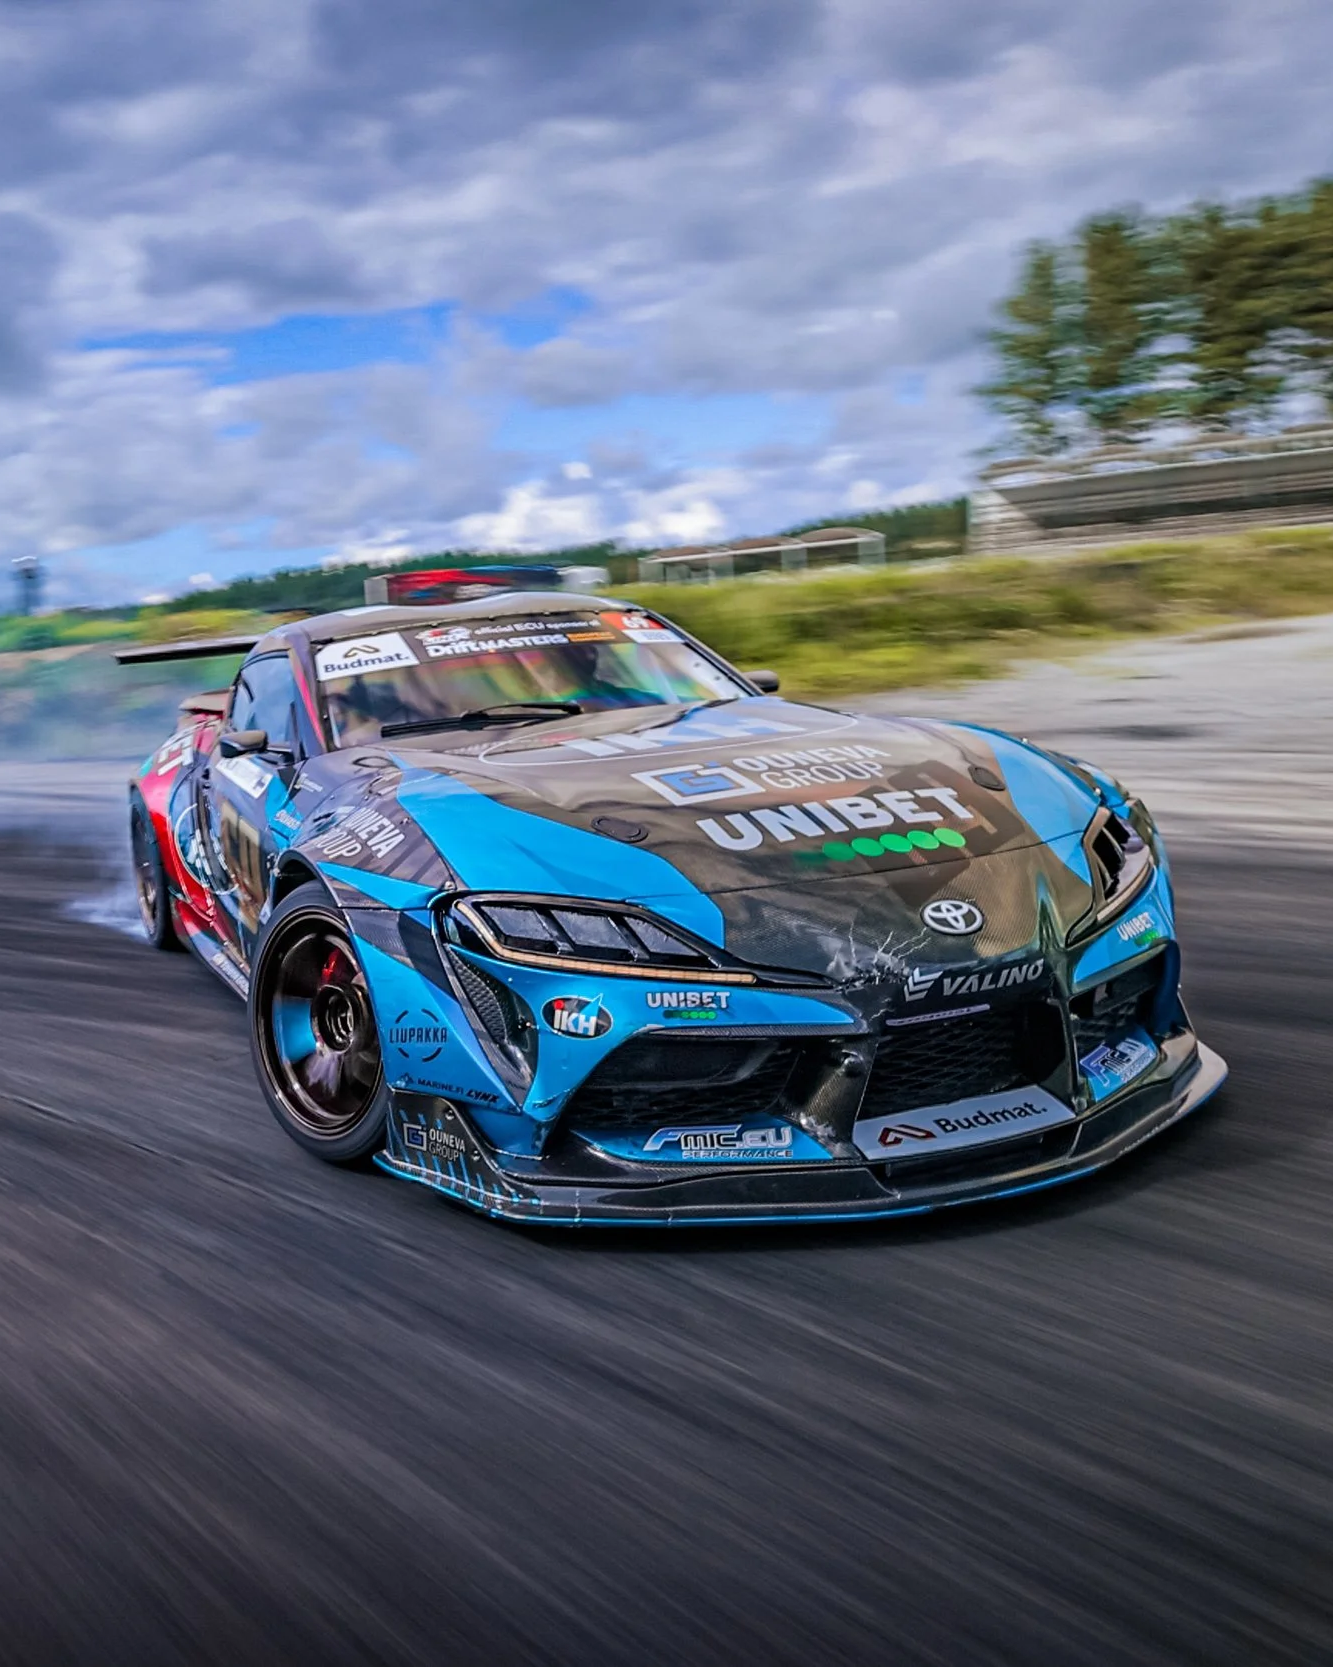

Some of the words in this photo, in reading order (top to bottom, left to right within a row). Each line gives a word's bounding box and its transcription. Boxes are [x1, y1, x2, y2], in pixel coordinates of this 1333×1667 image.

[513, 621, 544, 632] ECU
[621, 615, 650, 630] 69
[323, 652, 409, 674] Budmat.
[733, 744, 891, 773] OUNEVA
[760, 760, 886, 790] GROUP
[695, 787, 974, 851] UNIBET
[1116, 911, 1155, 942] UNIBET
[942, 958, 1045, 996] VALINO
[646, 991, 731, 1010] UNIBET
[389, 1027, 448, 1044] LIUPAKKA
[465, 1088, 501, 1104] LYNX
[932, 1102, 1048, 1134] Budmat.
[428, 1128, 466, 1153] OUNEVA
[428, 1141, 460, 1162] GROUP
[682, 1150, 794, 1160] PERFORMANCE
